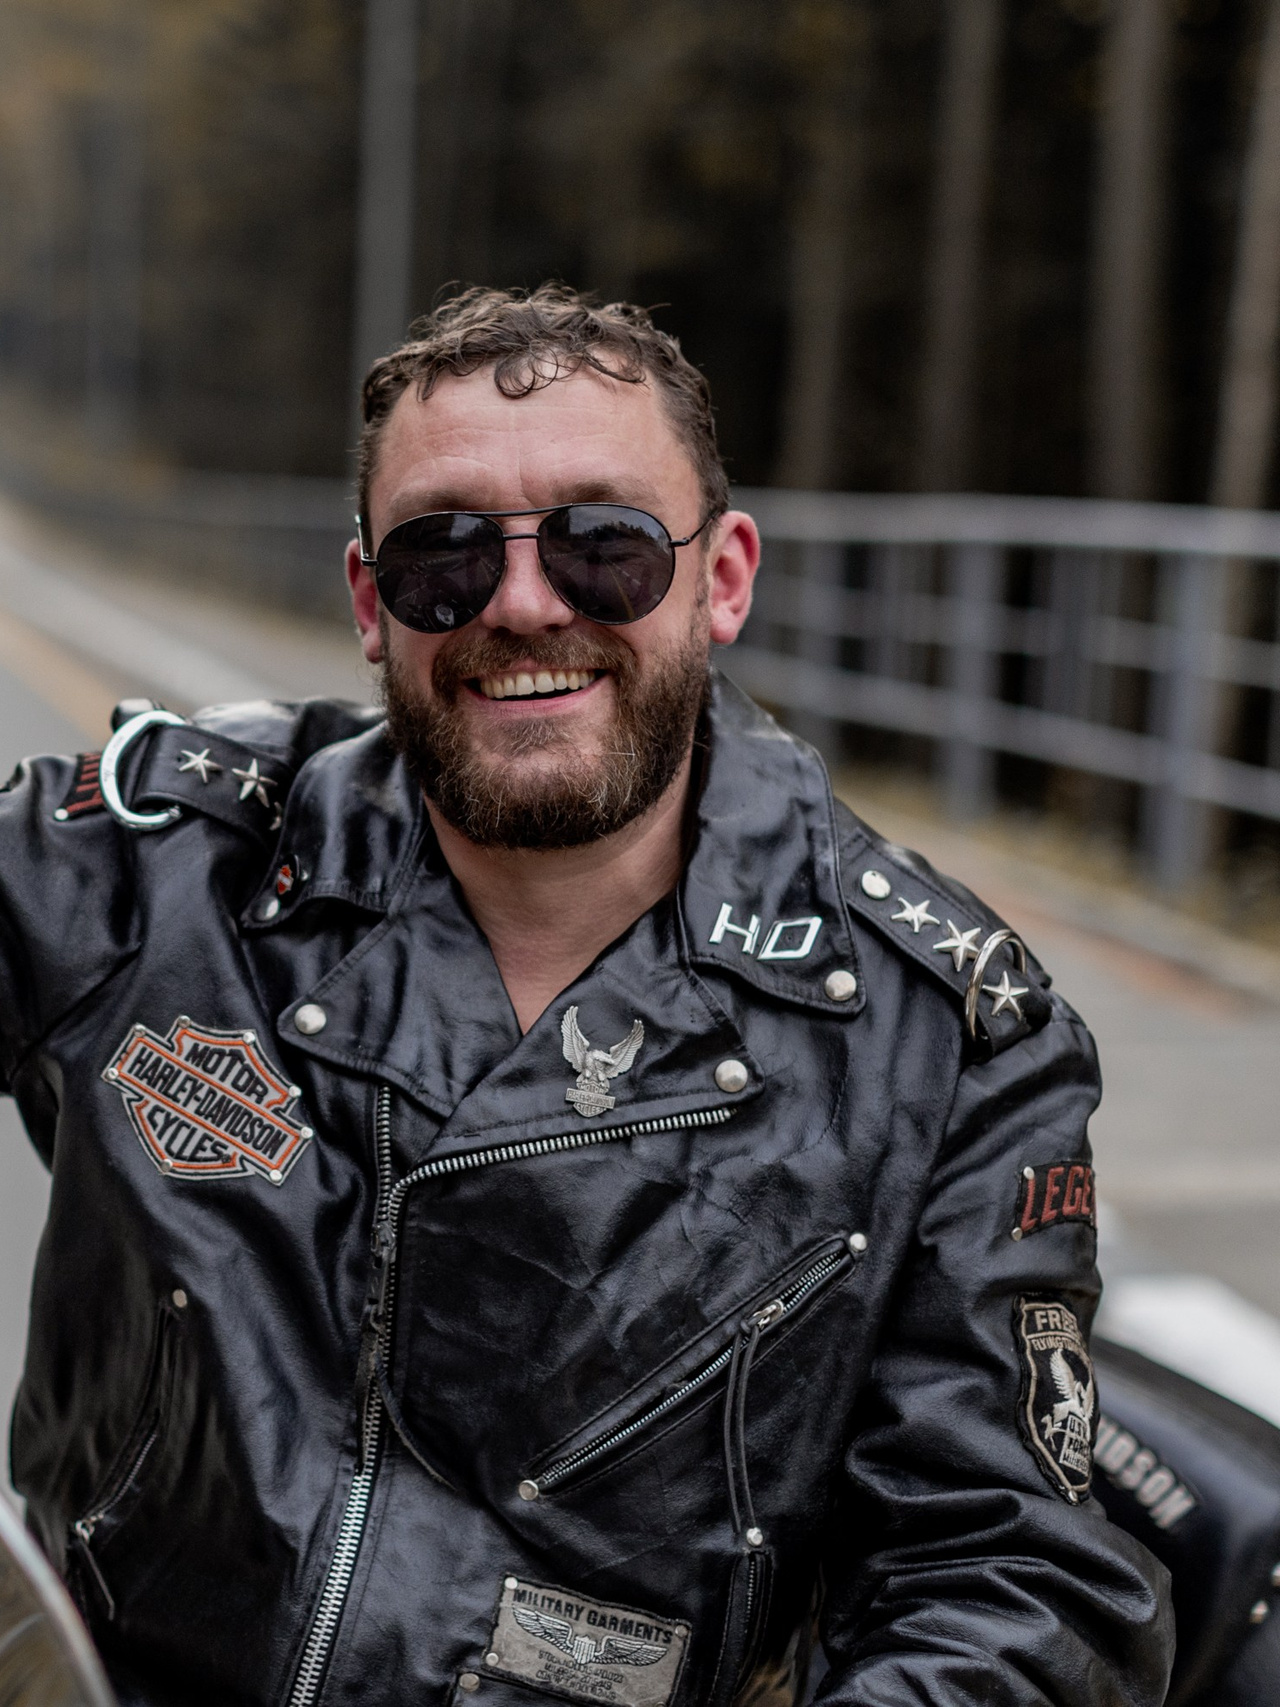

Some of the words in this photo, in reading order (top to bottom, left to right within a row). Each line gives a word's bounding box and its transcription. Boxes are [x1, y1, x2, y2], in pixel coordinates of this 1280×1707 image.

[709, 902, 822, 961] HD
[184, 1042, 269, 1104] MOTOR
[127, 1046, 289, 1160] HARLEY-DAVIDSON
[146, 1104, 229, 1163] CYCLES
[511, 1588, 585, 1621] MILITARY
[585, 1608, 674, 1644] GARMENTS
